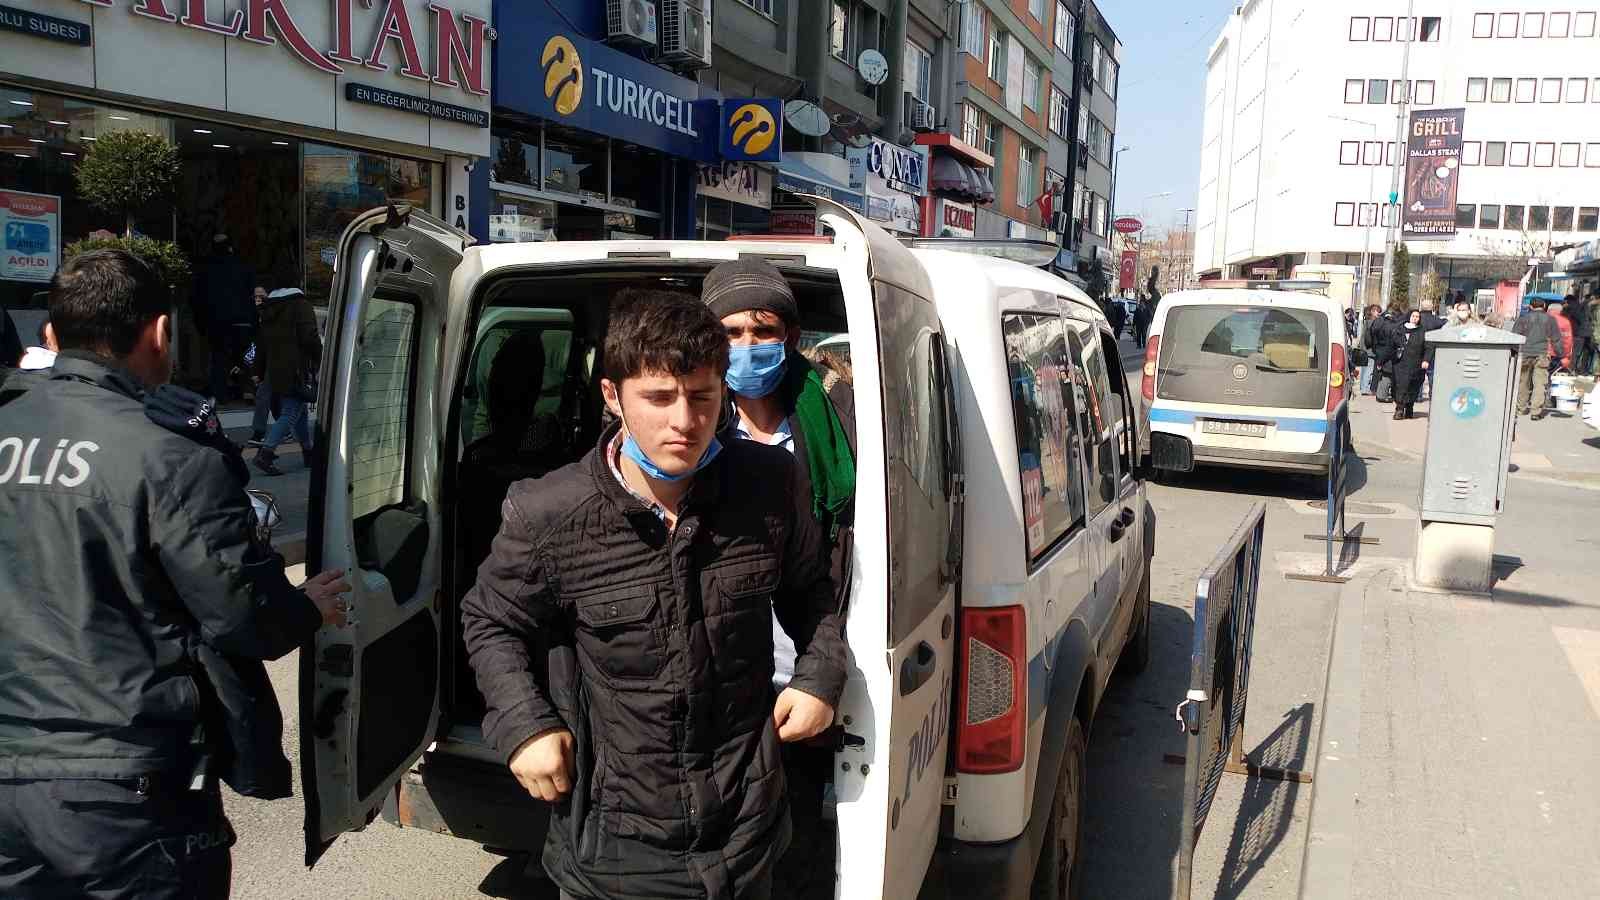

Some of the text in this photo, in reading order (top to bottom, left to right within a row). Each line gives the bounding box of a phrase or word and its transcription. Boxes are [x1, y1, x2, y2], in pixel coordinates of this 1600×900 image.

[356, 88, 370, 100] EN
[592, 67, 698, 137] TURKCELL
[1413, 121, 1460, 136] GRILL
[1410, 149, 1437, 157] DALLAS
